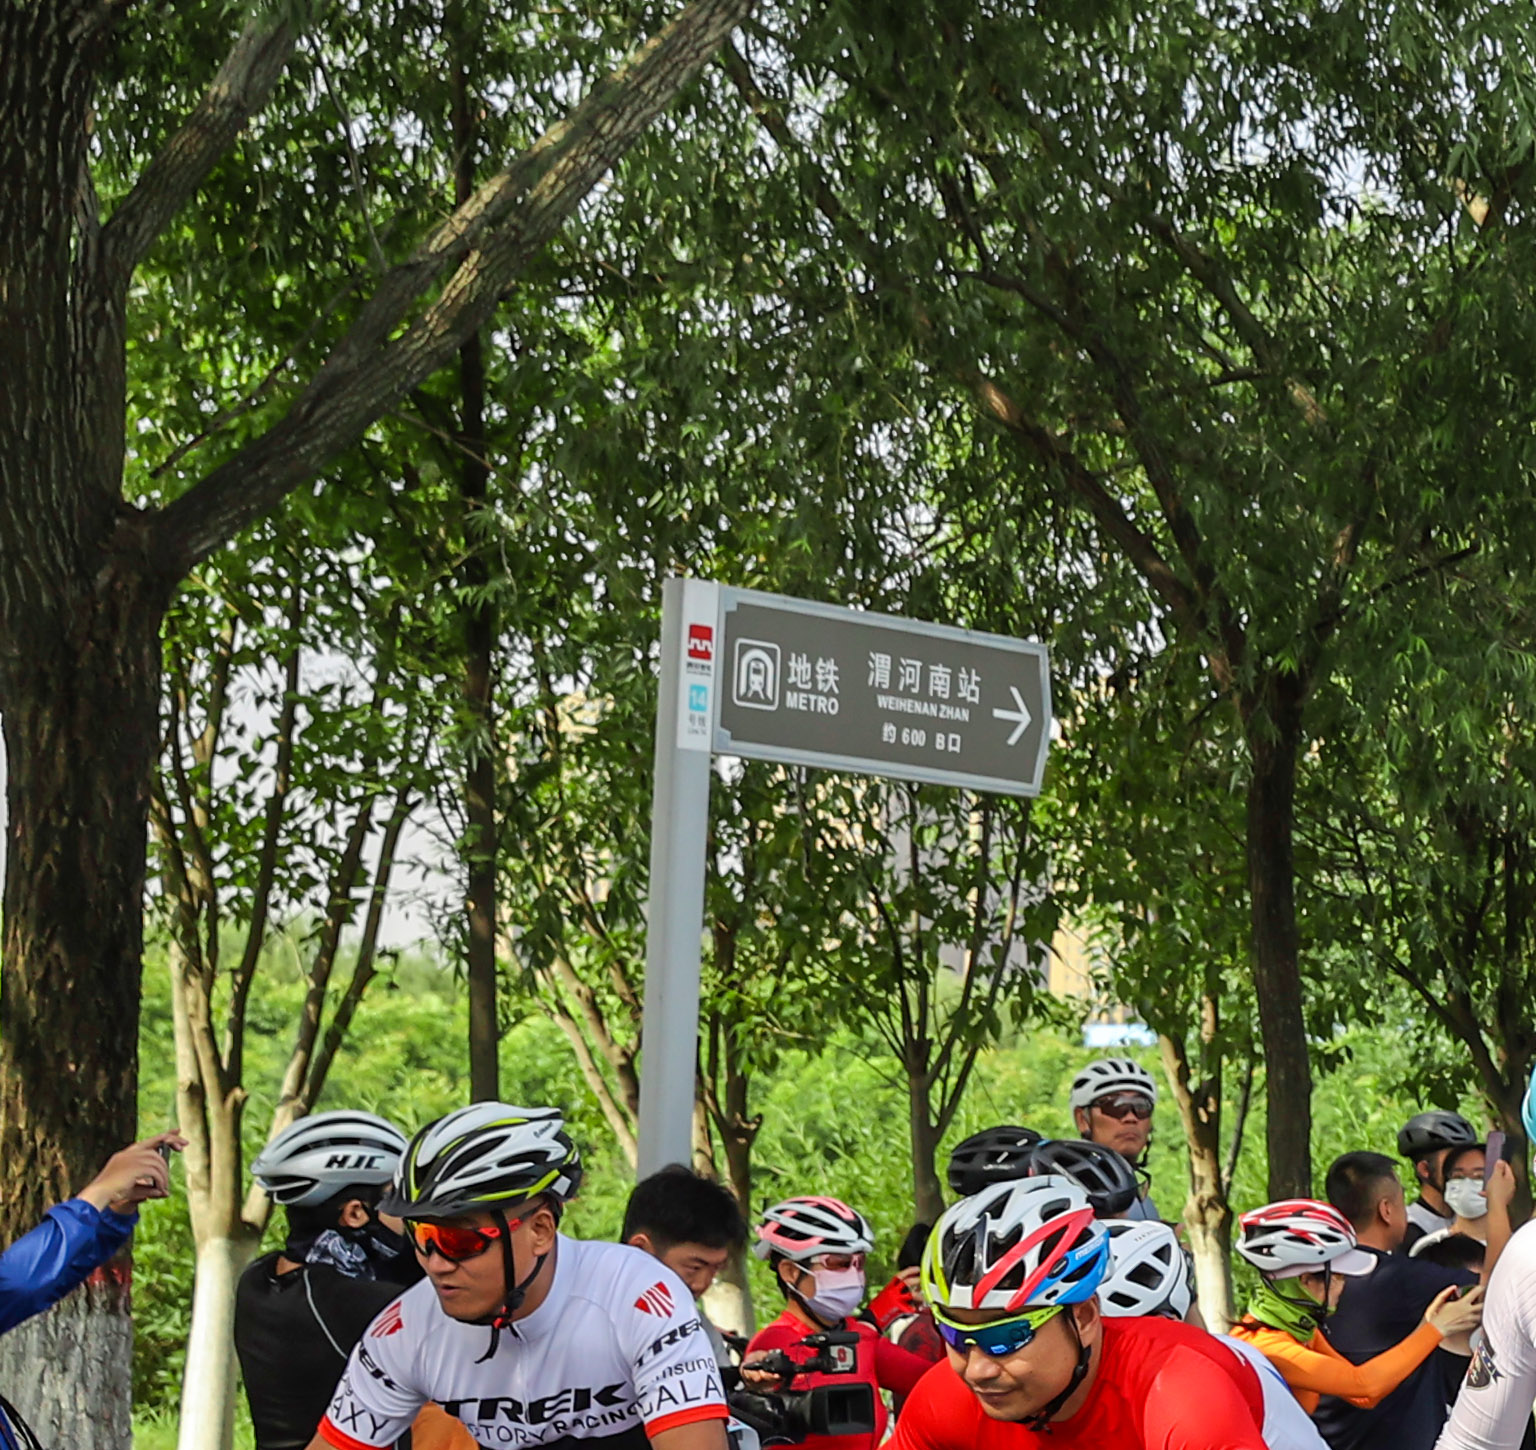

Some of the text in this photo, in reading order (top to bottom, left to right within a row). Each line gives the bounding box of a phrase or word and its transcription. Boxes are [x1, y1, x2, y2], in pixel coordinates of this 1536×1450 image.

[787, 650, 983, 704] 地铁 渭河南站
[786, 691, 970, 723] METRO WEIHENAN ZHAN
[901, 727, 926, 747] 600
[935, 733, 962, 754] B口
[324, 1154, 385, 1171] HJC
[432, 1381, 635, 1425] TREK
